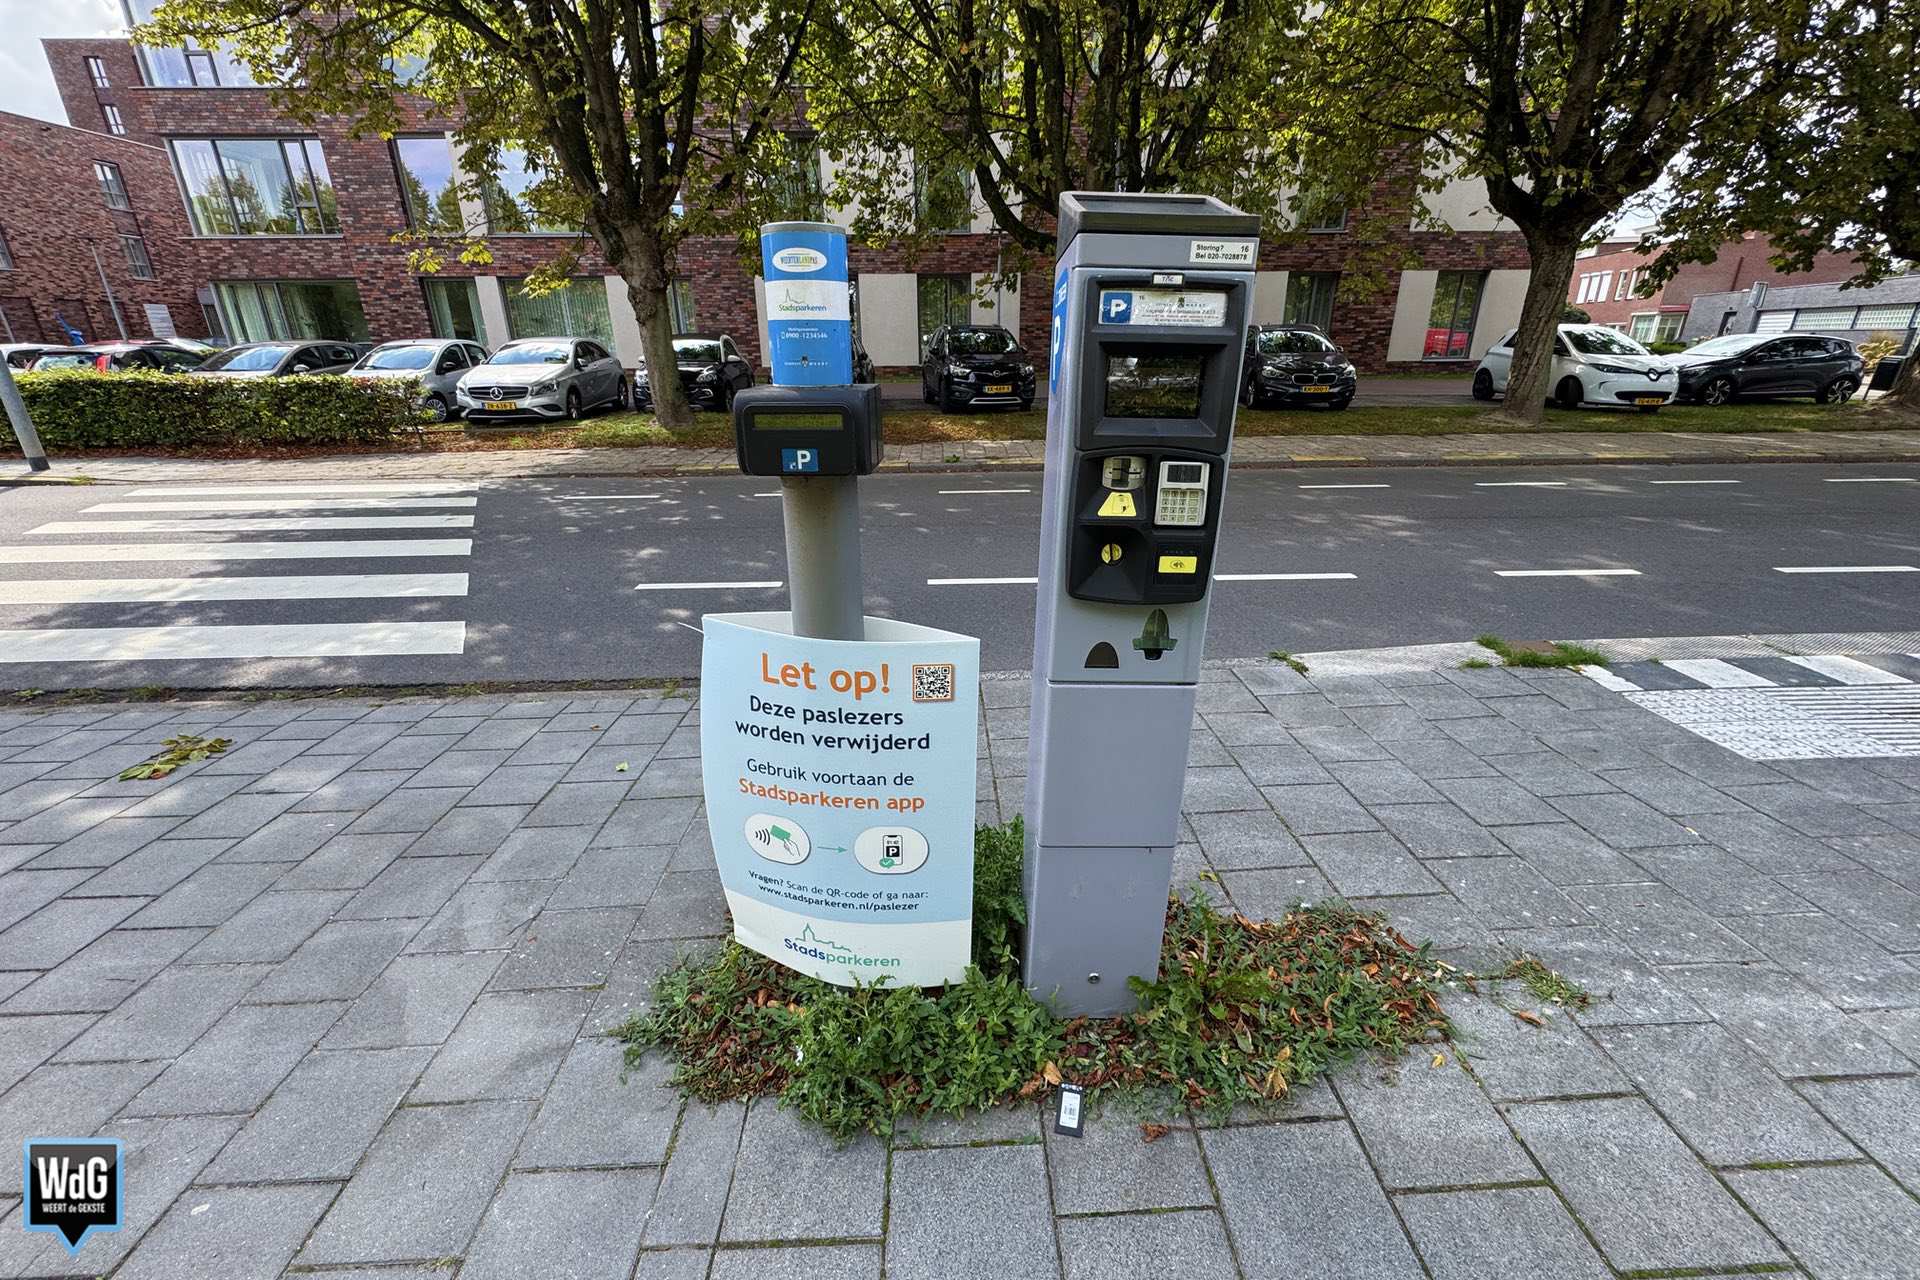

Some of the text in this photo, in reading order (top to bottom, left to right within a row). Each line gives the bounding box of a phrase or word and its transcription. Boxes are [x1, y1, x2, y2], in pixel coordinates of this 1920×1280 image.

[1196, 244, 1249, 253] Storing? 16
[779, 304, 827, 312] Stadsparkeren
[1110, 299, 1127, 318] P
[797, 450, 811, 470] P
[761, 652, 890, 701] Let op!
[750, 695, 904, 725] Deze paslezers
[735, 720, 930, 754] worden verwijderd
[746, 758, 914, 786] Gebruik voortaan de
[738, 777, 925, 813] Stadsparkeren app
[889, 847, 898, 857] P
[748, 869, 929, 901] Vragen? Scan de QR-code of ga naar:
[758, 884, 920, 912] www.stadsparkeren.nl/paslezer
[784, 937, 901, 968] Stadsparkeren
